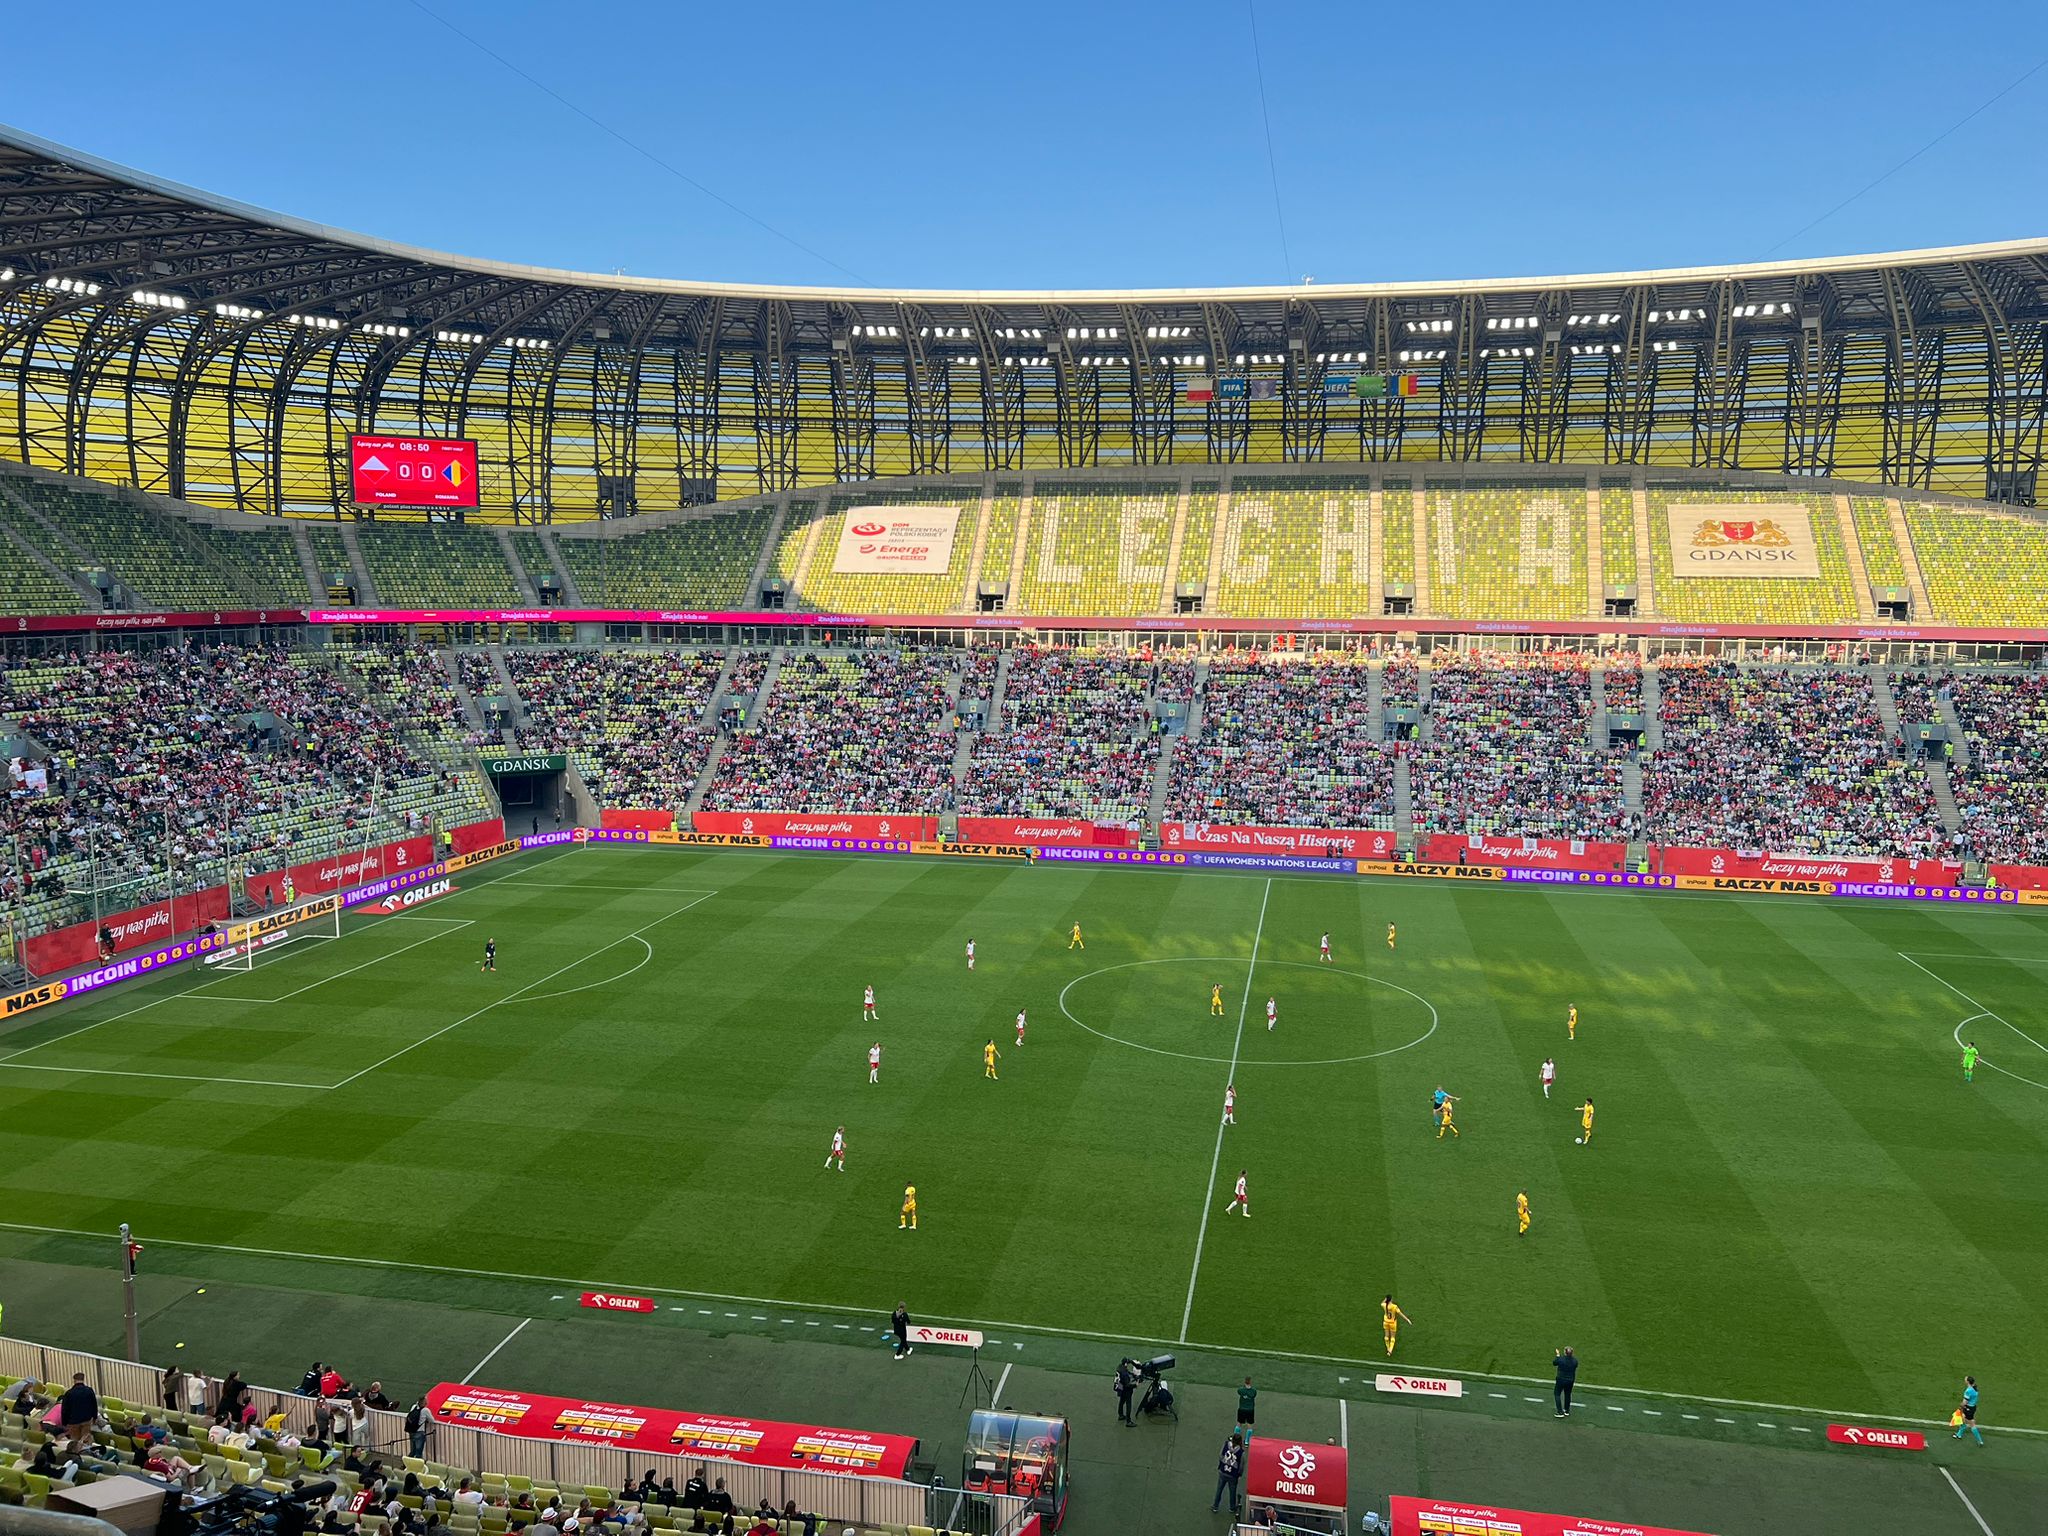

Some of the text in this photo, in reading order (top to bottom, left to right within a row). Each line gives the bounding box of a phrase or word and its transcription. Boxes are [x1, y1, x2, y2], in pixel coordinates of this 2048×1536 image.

[1223, 384, 1241, 392] FIFA
[1324, 384, 1348, 392] UEFA
[400, 442, 430, 452] 08:50
[400, 465, 410, 478] 0
[422, 465, 432, 478] 0
[1038, 498, 1571, 584] LECHIA
[880, 545, 928, 554] Energa
[1690, 548, 1797, 561] GDAŃSK
[493, 758, 551, 772] GDAŃSK
[785, 820, 852, 835] Łączy nas piłka
[1014, 825, 1041, 839] Łączy
[1041, 826, 1057, 838] nas
[1057, 827, 1082, 839] piłka
[523, 831, 571, 846] INCOIN
[678, 833, 760, 844] ŁĄCZY NAS
[776, 837, 828, 847] INCOIN
[1196, 828, 1355, 850] Czas Na Naszą Historię
[465, 841, 515, 865] ŁĄCZY NAS
[942, 844, 1027, 856] ŁĄCZY NAS
[1045, 848, 1099, 859] INCOIN
[1480, 844, 1511, 859] Łączy
[1529, 848, 1558, 860] piłka
[345, 863, 359, 875] nas
[1204, 856, 1340, 869] UEFA WOMEN'S NATIONS LEAGUE
[1393, 864, 1492, 877] ŁĄCZY NAS
[1511, 870, 1574, 882] INCOIN
[1761, 861, 1848, 878] Łączy nas piłka
[402, 878, 451, 906] ORLEN
[1714, 879, 1820, 892] ŁĄCZY NAS
[1841, 884, 1909, 896] INCOIN
[347, 881, 388, 904] INCOIN
[126, 919, 144, 934] nas
[144, 910, 169, 934] piłka
[258, 900, 335, 931] ŁĄCZY NAS
[71, 959, 137, 992] INCOIN
[6, 988, 51, 1013] NAS
[609, 1298, 640, 1308] ORLEN
[936, 1332, 968, 1342] ORLEN
[1411, 1380, 1446, 1391] ORLEN
[1867, 1432, 1908, 1445] ORLEN
[1276, 1480, 1315, 1496] POLSKA
[350, 1496, 364, 1511] 13
[1433, 1504, 1459, 1514] Łączy
[1474, 1510, 1498, 1518] piłka
[1577, 1520, 1603, 1530] Łączy
[1620, 1528, 1644, 1536] piłka
